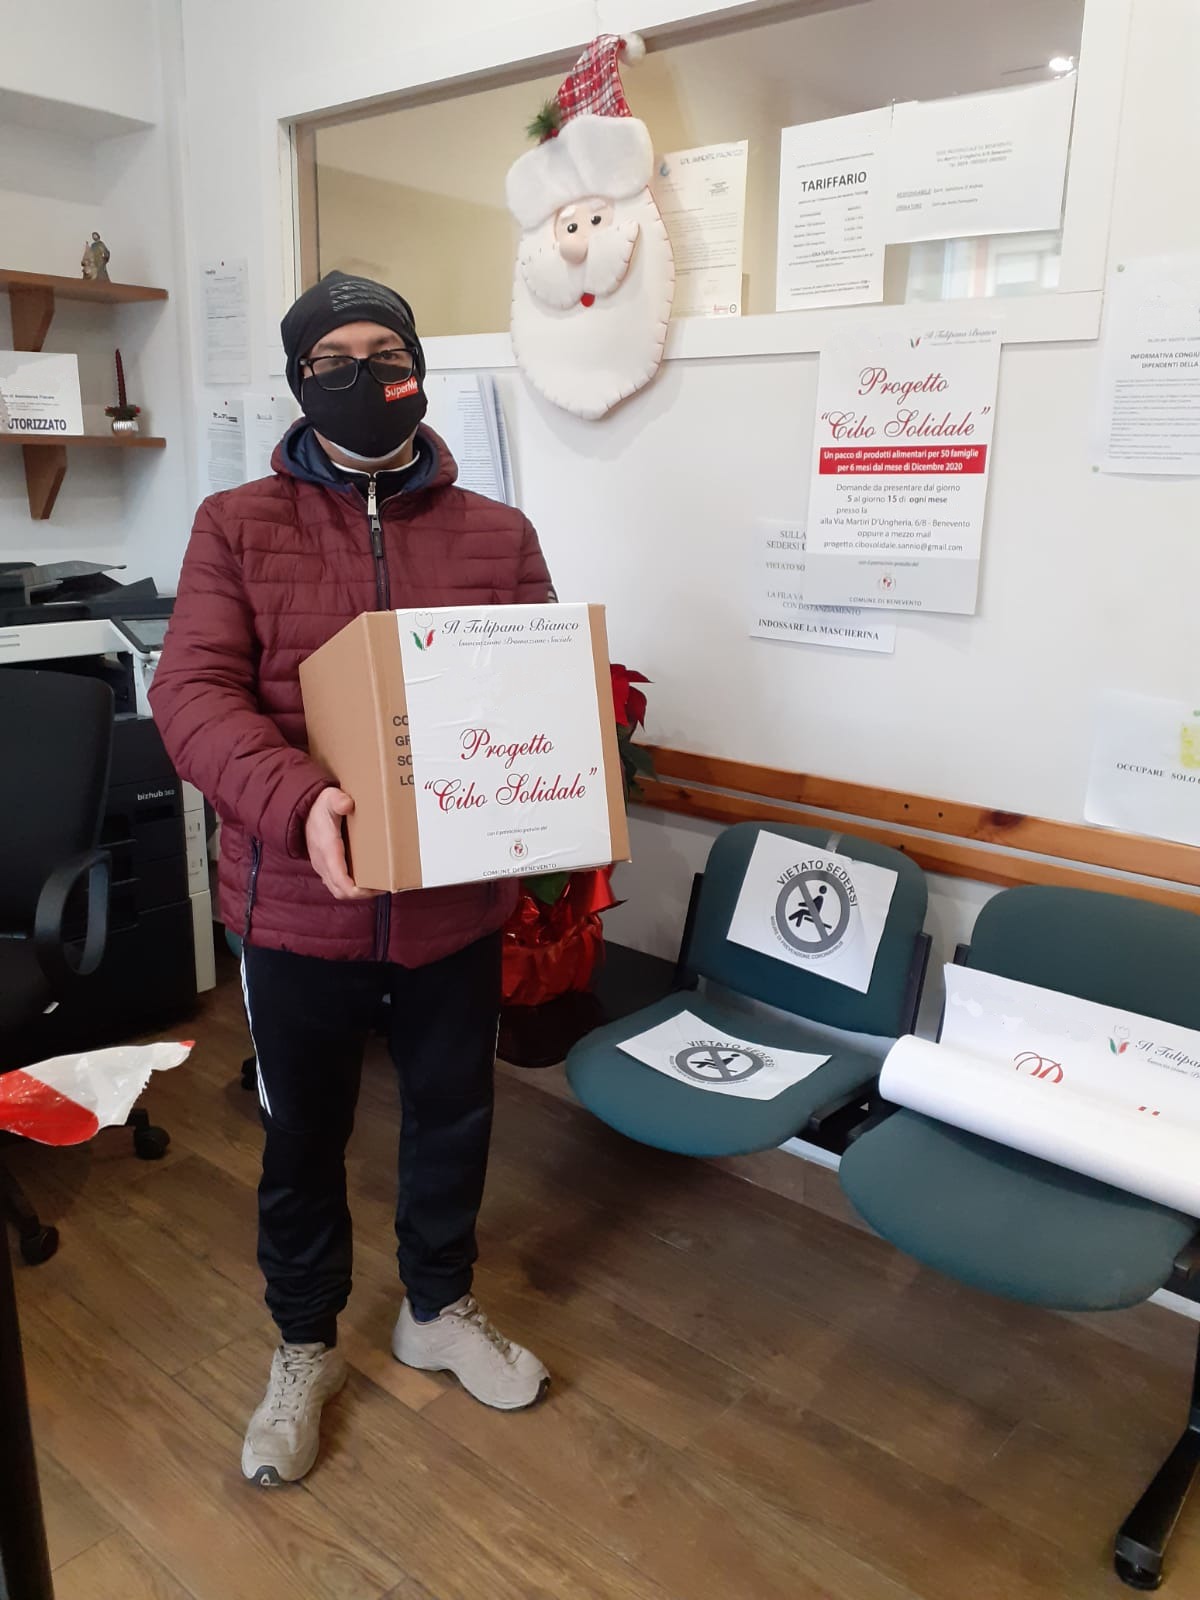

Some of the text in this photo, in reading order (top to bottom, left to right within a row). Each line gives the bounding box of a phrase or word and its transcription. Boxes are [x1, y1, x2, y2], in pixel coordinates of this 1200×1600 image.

[801, 171, 867, 193] TARIFFARIO
[1130, 352, 1174, 360] INFORMATIVA
[1141, 361, 1179, 369] DIPENDENTI
[858, 366, 950, 406] Progetto
[8, 417, 67, 431] UTORIZZATO
[824, 449, 979, 460] Un pacco di prodotti alimentari per 50 famiglie
[837, 464, 849, 473] per
[850, 463, 855, 471] 6
[855, 463, 871, 471] mesi
[872, 462, 883, 471] dal
[903, 462, 911, 471] di
[911, 462, 944, 471] Dicembre
[945, 462, 963, 471] 2020
[836, 483, 960, 493] Domande da presentare dal giorno
[847, 495, 947, 504] 5 al giorno 15 di ogni mese
[836, 506, 868, 515] presso la
[820, 517, 833, 525] alla
[846, 518, 869, 526] Martiri
[915, 519, 927, 527] 6/8
[932, 519, 971, 528] Benevento
[780, 530, 807, 540] SULLA
[857, 530, 883, 539] oppure
[916, 530, 932, 538] mail
[766, 540, 800, 551] SEDERSI
[766, 561, 795, 570] VIETATO
[767, 591, 776, 599] LA
[777, 591, 793, 600] FILA
[849, 596, 876, 604] COMUNE
[886, 599, 922, 607] BENEVENTO
[782, 601, 862, 616] CON DISTANZIAMENTO
[441, 617, 579, 638] Il Tulipano Bianco
[758, 618, 880, 641] INDOSSARE LA MASCHERINA
[459, 728, 554, 769] Progetto
[1116, 762, 1165, 777] OCCUPARE
[1171, 772, 1196, 784] SOLO
[137, 790, 163, 801] bizhub
[520, 863, 557, 872] BENEVENTO
[777, 860, 858, 907] VIETATO SEDERSI
[687, 1040, 741, 1050] VIETATO
[1135, 1039, 1200, 1067] Il Tulipa
